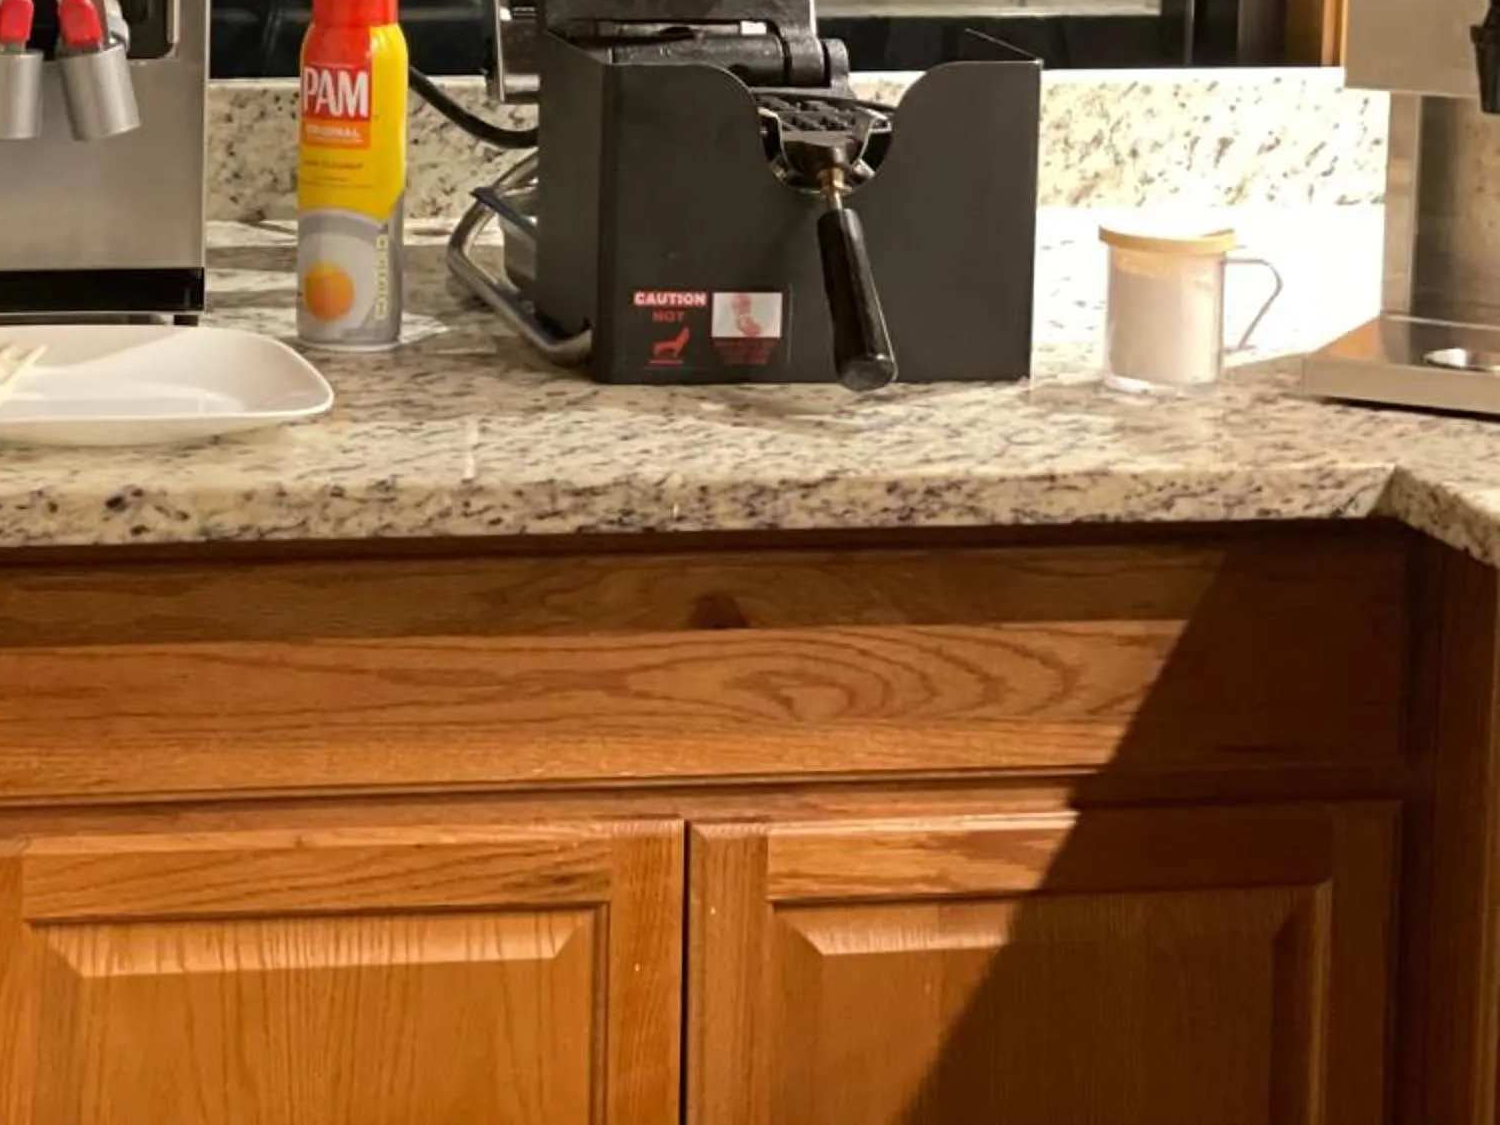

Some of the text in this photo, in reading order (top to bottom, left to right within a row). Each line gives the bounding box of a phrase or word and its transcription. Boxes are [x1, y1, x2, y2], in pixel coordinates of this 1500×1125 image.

[303, 67, 369, 118] PAM
[633, 291, 707, 306] CAUTION
[651, 310, 685, 323] HOT
